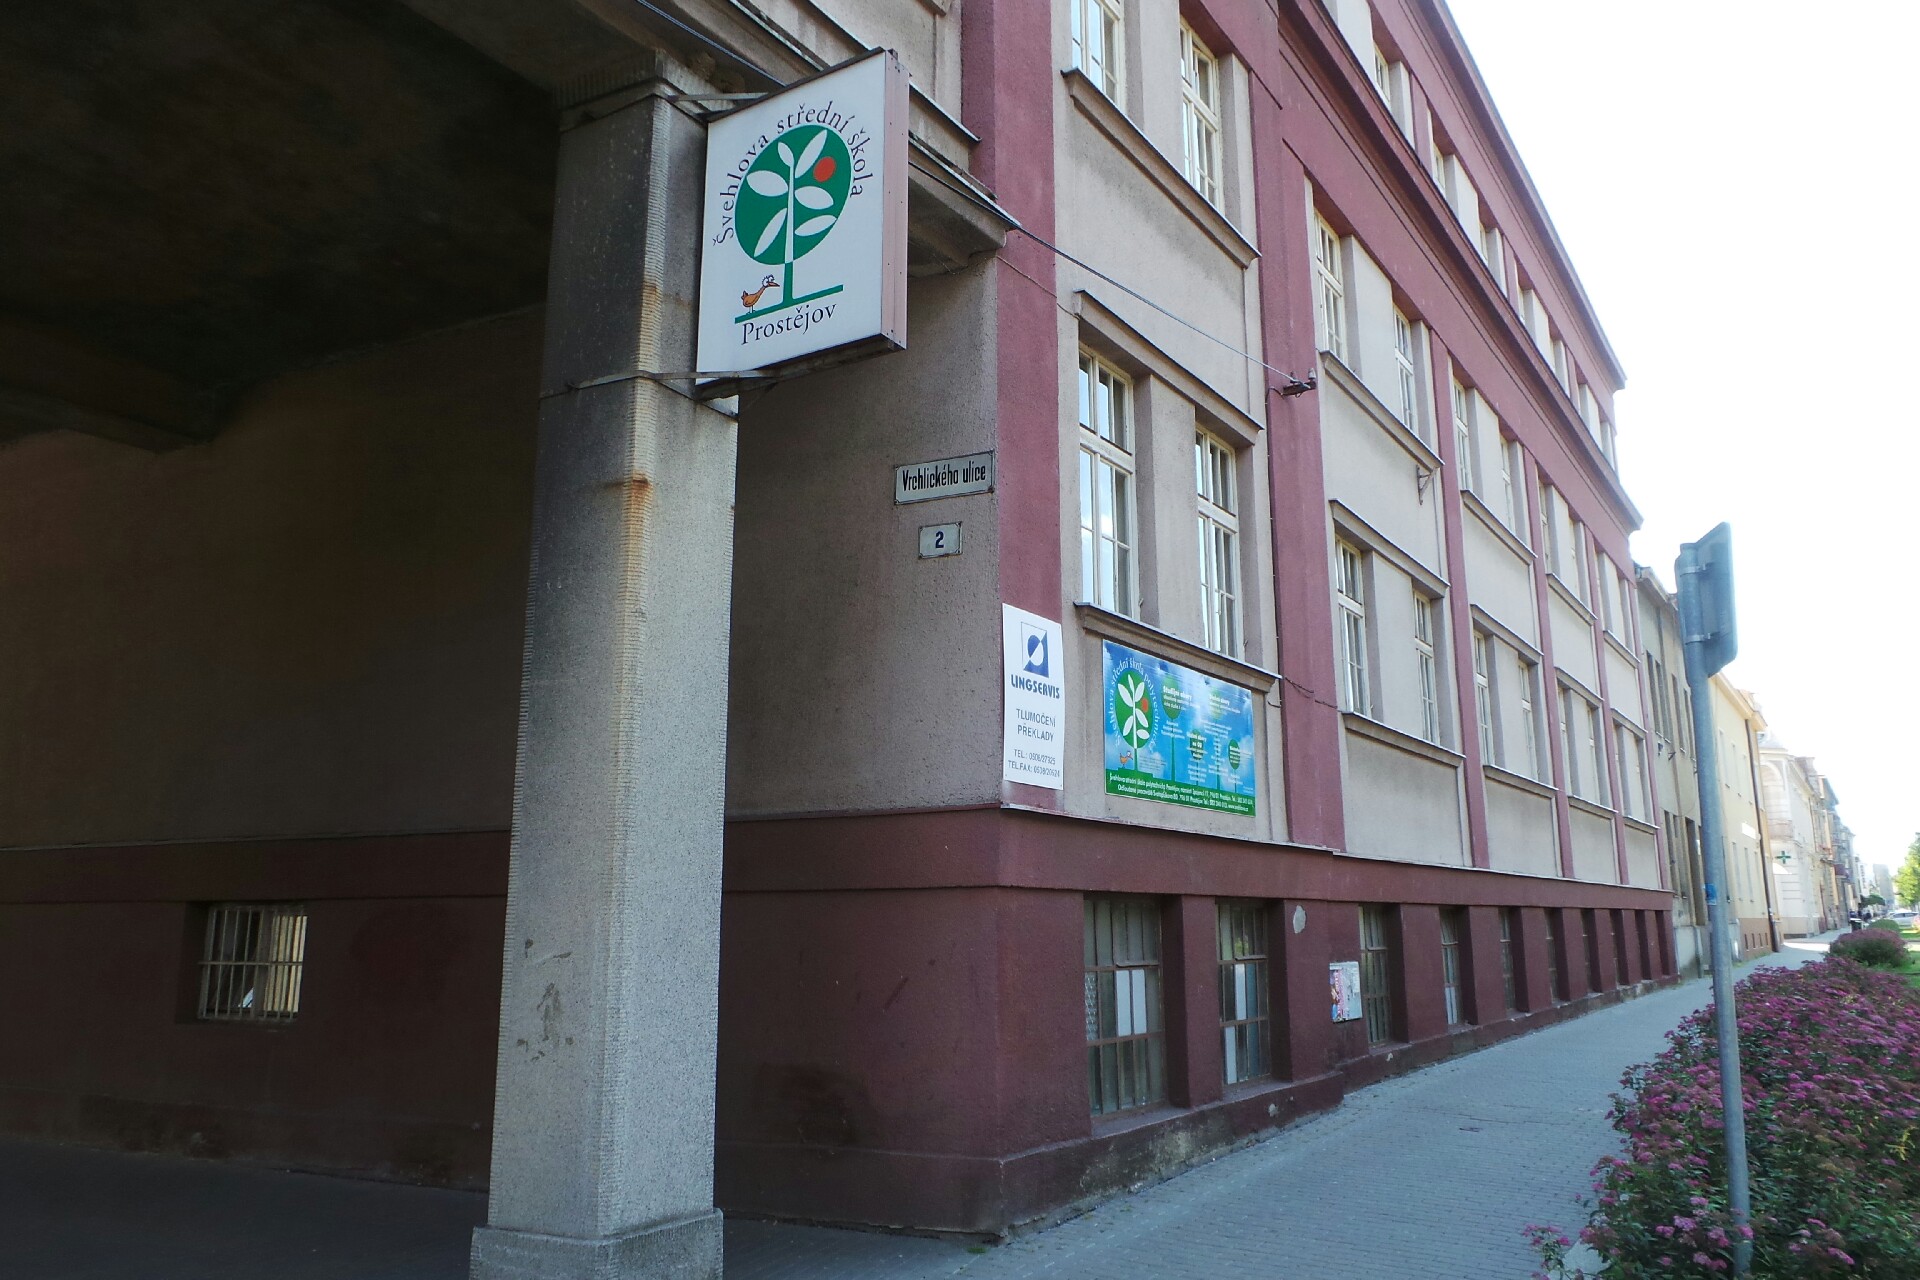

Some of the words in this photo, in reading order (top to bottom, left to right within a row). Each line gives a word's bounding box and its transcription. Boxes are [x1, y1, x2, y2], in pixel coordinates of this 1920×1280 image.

[713, 134, 769, 247] Švehlova
[776, 101, 855, 134] střední
[847, 127, 873, 198] škola
[741, 303, 836, 345] Prostějov
[902, 464, 959, 491] Vrchlického
[962, 460, 986, 484] ulice
[935, 530, 945, 549] 2
[1010, 674, 1060, 699] LINGSERVIS
[1016, 708, 1056, 728] TLUMOČENÍ
[1017, 723, 1054, 742] PŘEKLADY
